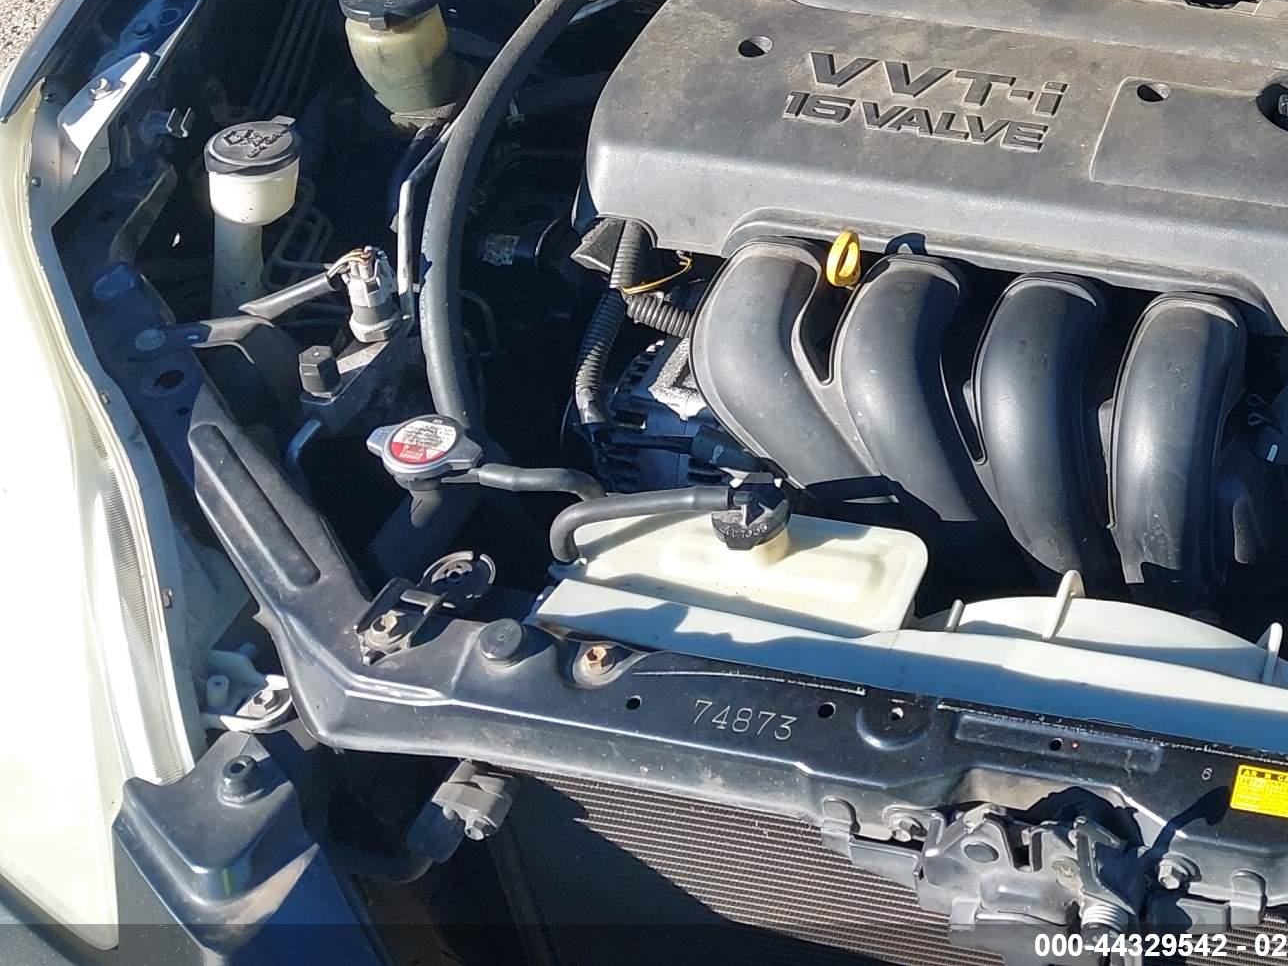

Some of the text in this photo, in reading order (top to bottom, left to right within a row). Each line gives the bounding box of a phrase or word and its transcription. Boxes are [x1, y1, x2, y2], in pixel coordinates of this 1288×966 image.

[809, 50, 1070, 118] VVT-i
[783, 90, 1050, 153] 16 VALVE
[693, 698, 799, 741] 74873
